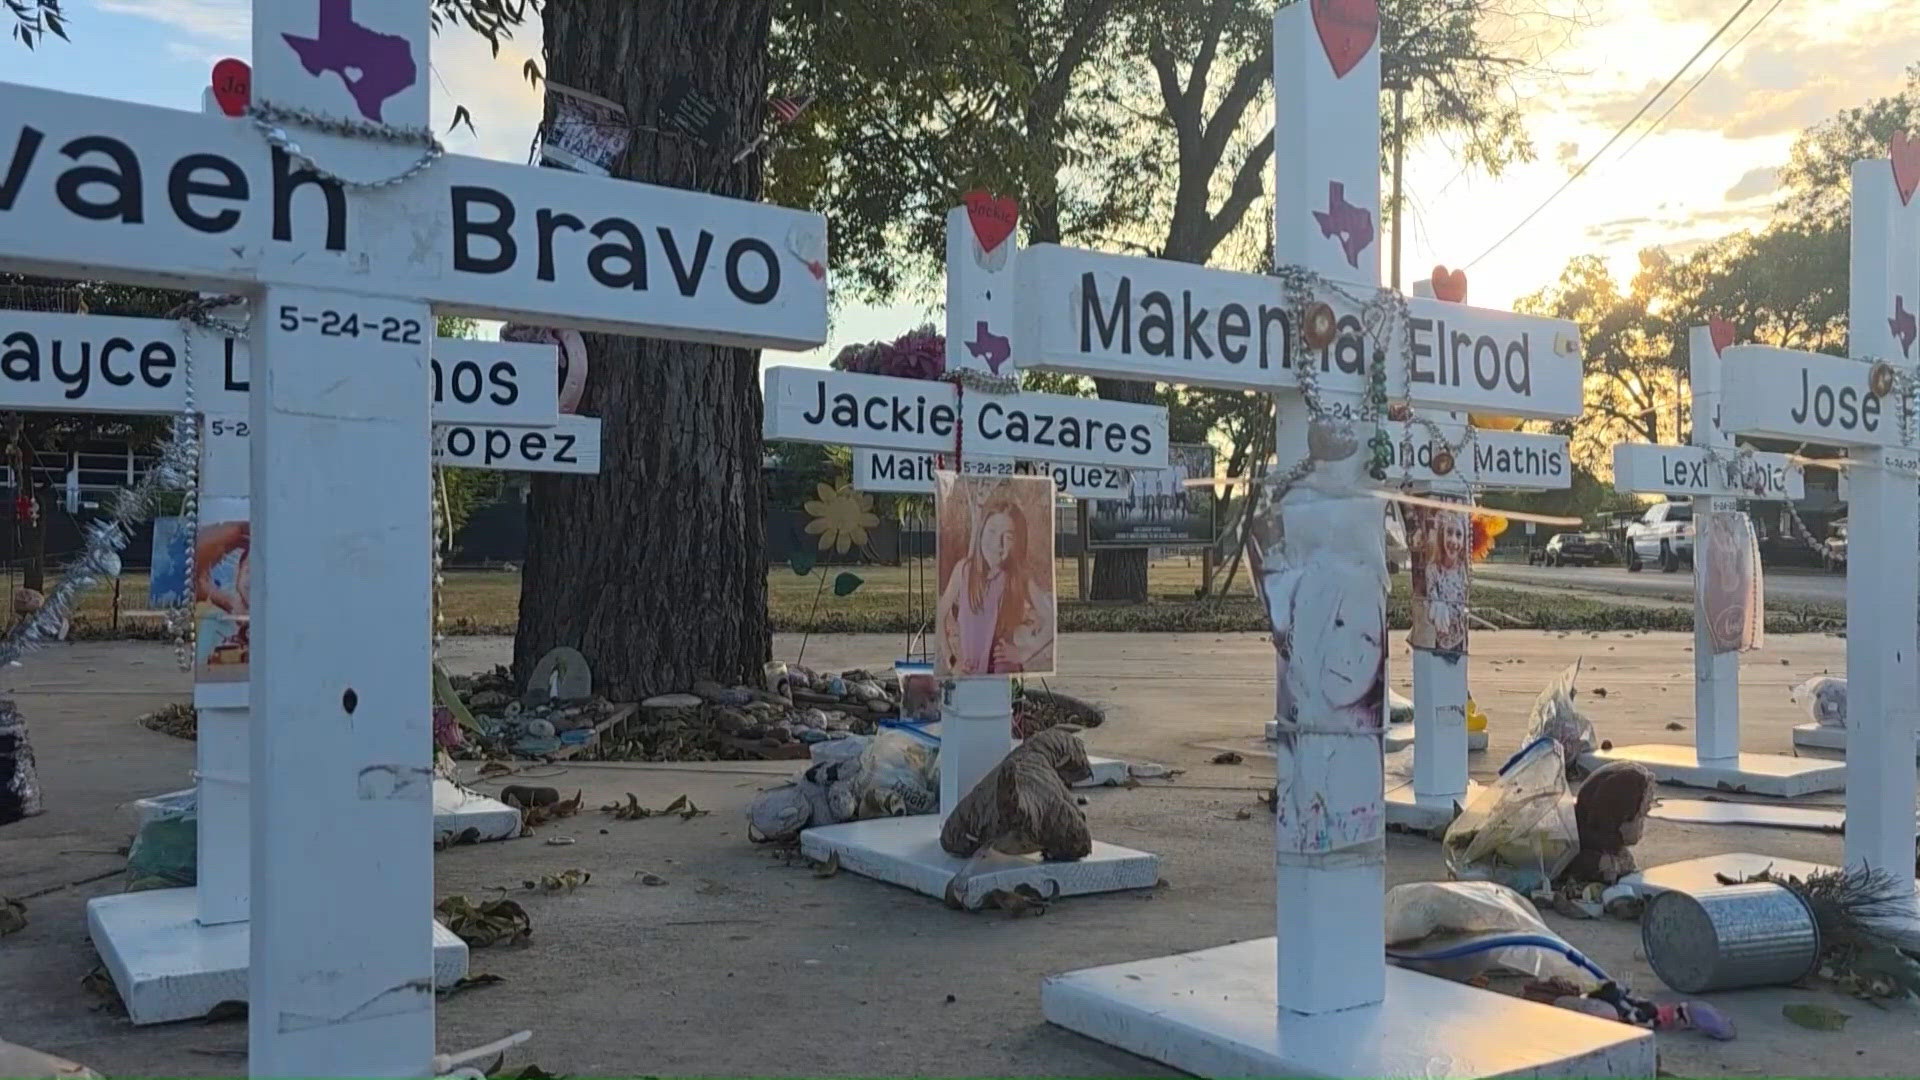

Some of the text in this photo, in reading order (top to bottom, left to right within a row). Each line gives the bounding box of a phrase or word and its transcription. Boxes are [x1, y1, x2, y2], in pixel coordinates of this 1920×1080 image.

[450, 185, 781, 305] Bravo
[279, 305, 422, 345] 5-24-22
[1079, 272, 1531, 396] Makena Elrod
[803, 381, 1152, 455] Jackie Cazares
[433, 426, 577, 465] opez
[1474, 444, 1562, 476] Mathis
[963, 462, 1013, 475] 5-24-22
[1661, 455, 1708, 488] Lexi
